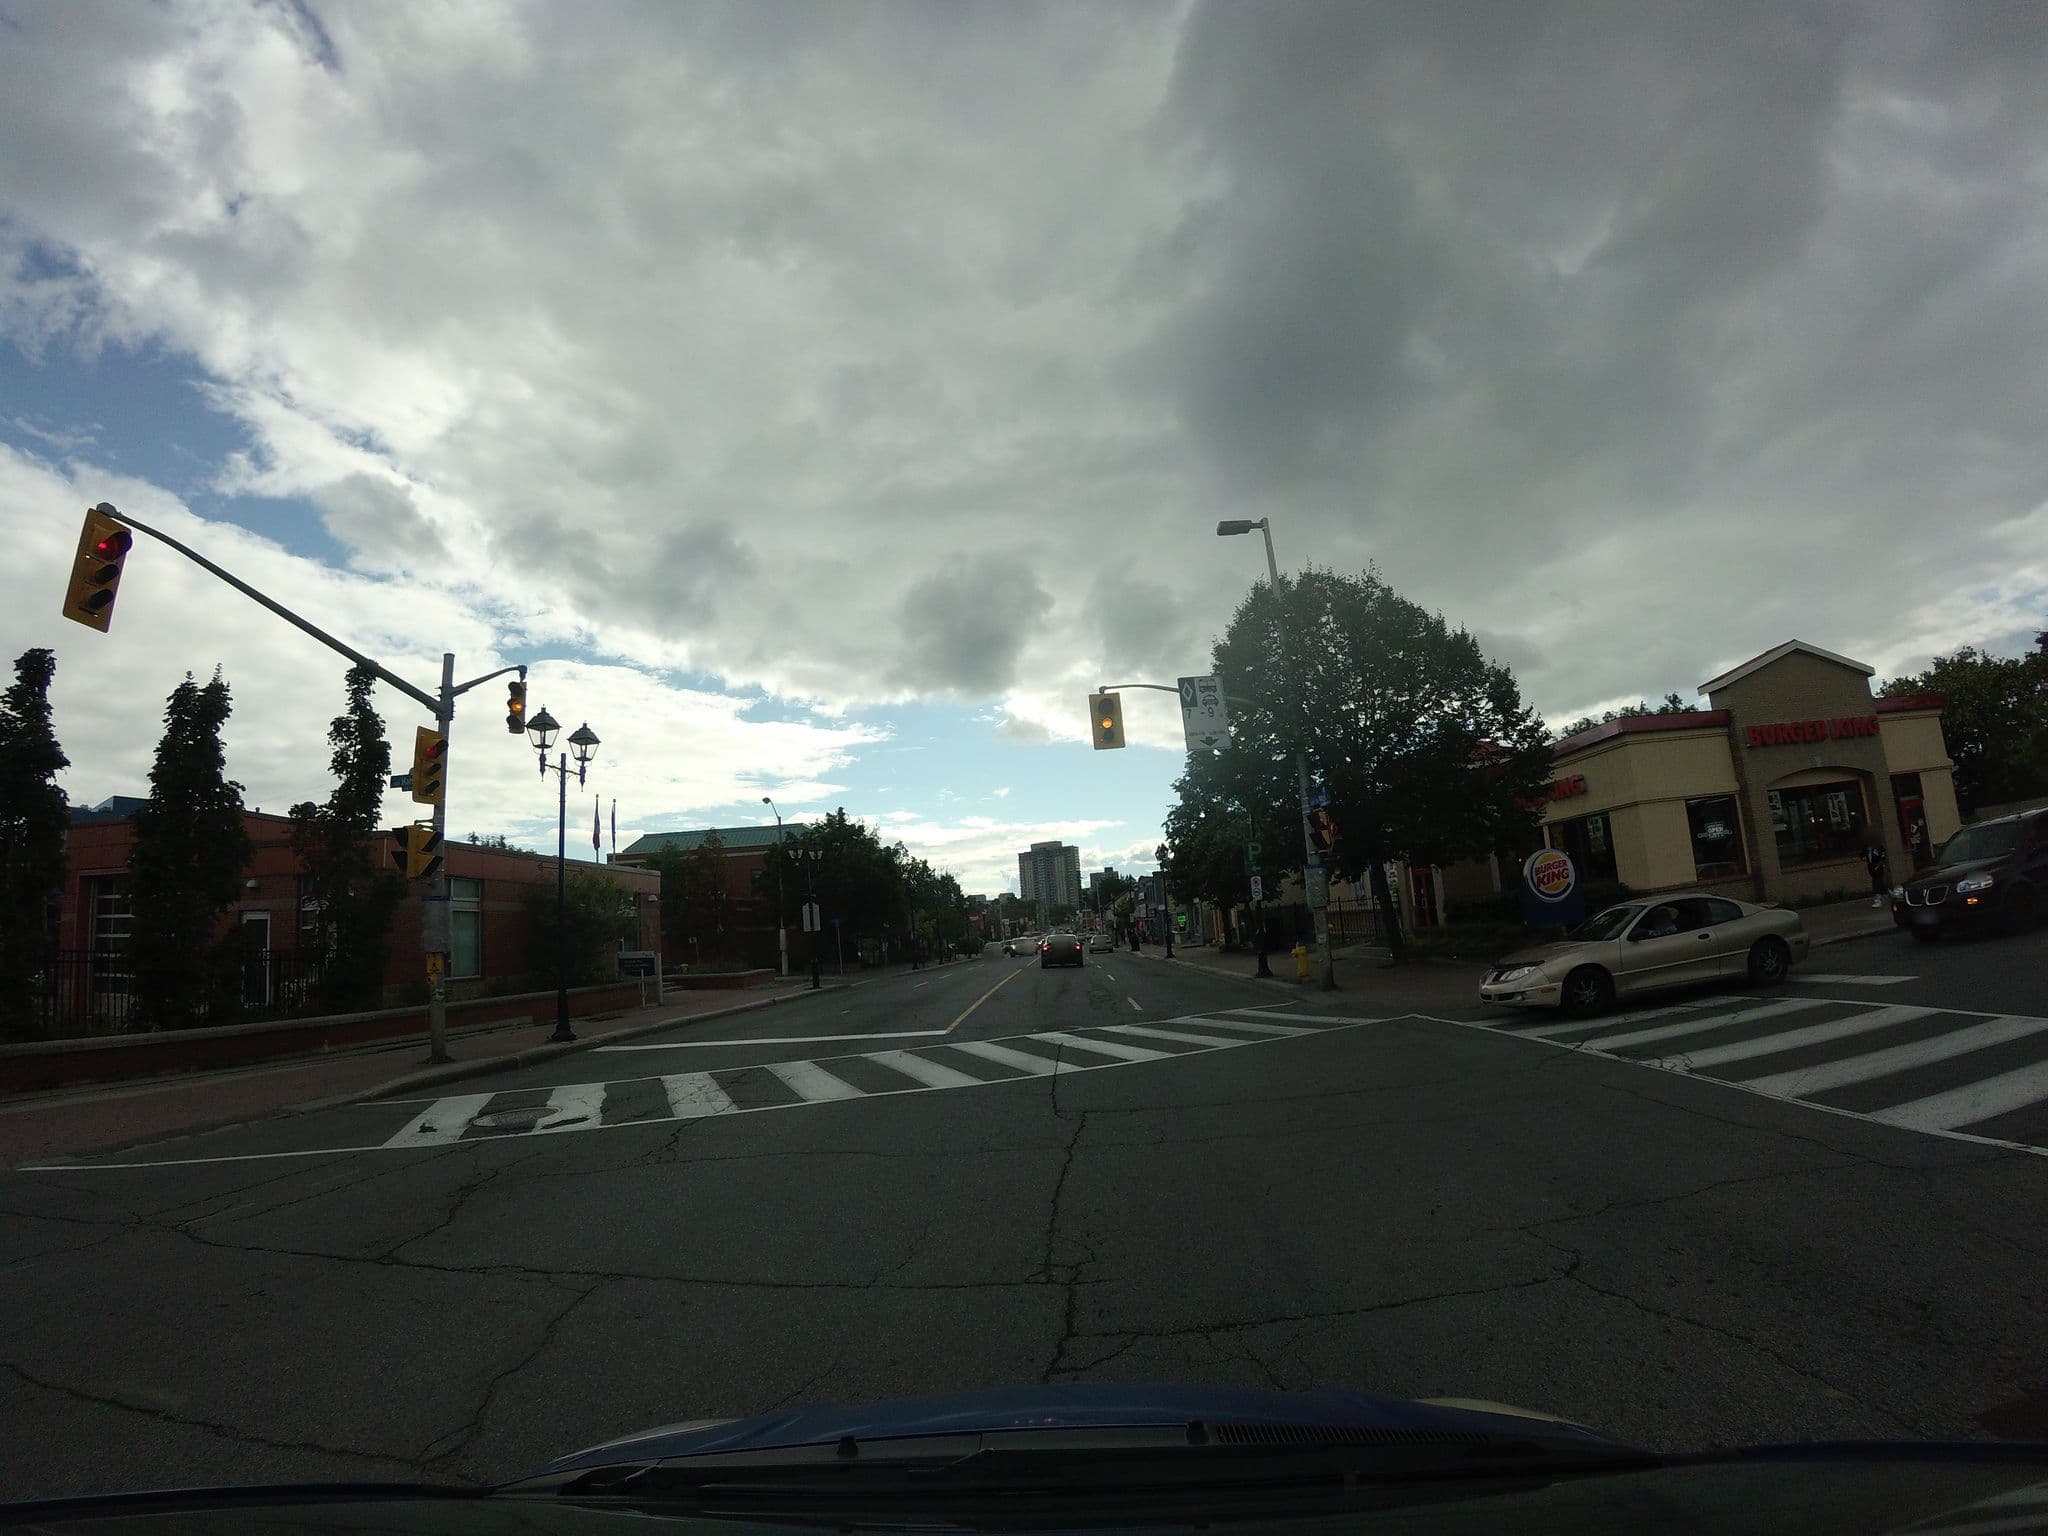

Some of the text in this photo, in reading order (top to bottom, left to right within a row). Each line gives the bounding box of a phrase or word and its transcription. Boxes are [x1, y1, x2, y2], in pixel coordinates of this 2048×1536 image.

[1748, 715, 1881, 746] BURGER KING
[1248, 843, 1262, 860] P
[1535, 859, 1568, 876] BURGER
[1536, 868, 1569, 888] KING
